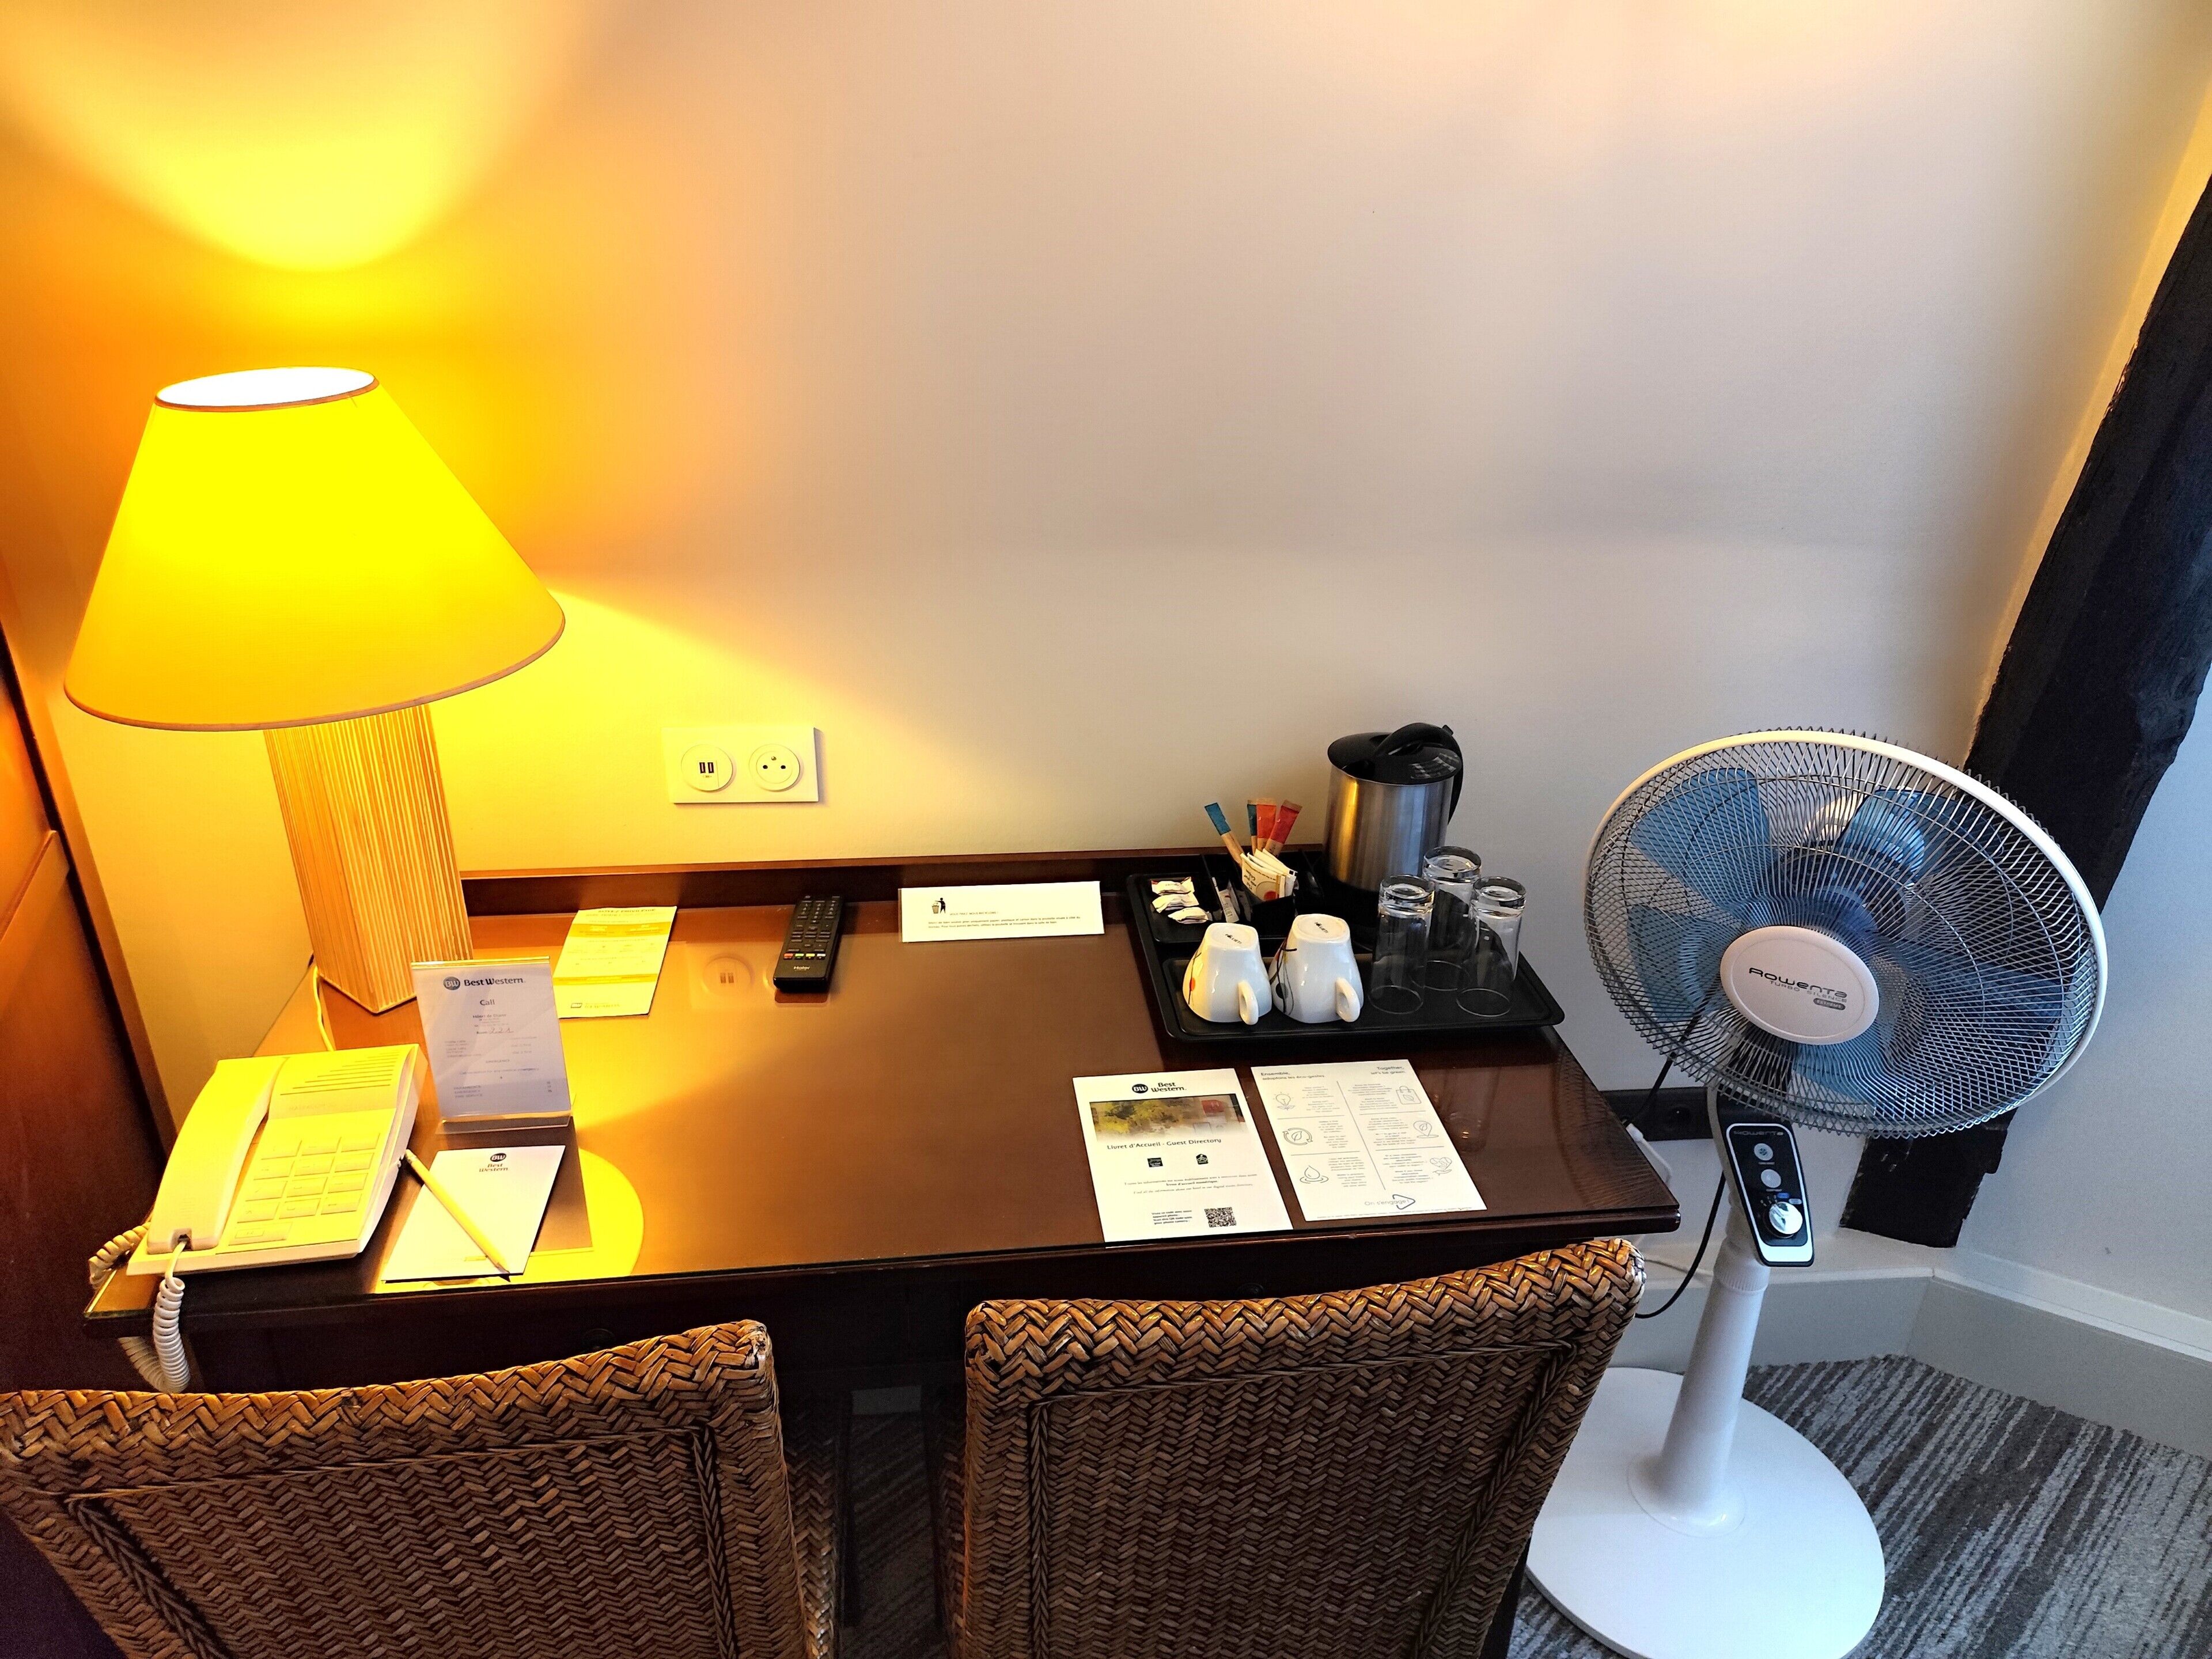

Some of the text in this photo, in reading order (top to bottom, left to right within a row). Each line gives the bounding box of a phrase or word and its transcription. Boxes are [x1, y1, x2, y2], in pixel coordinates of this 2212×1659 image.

[485, 978, 524, 986] Western
[1770, 980, 1847, 1003] TURBO SILENCE
